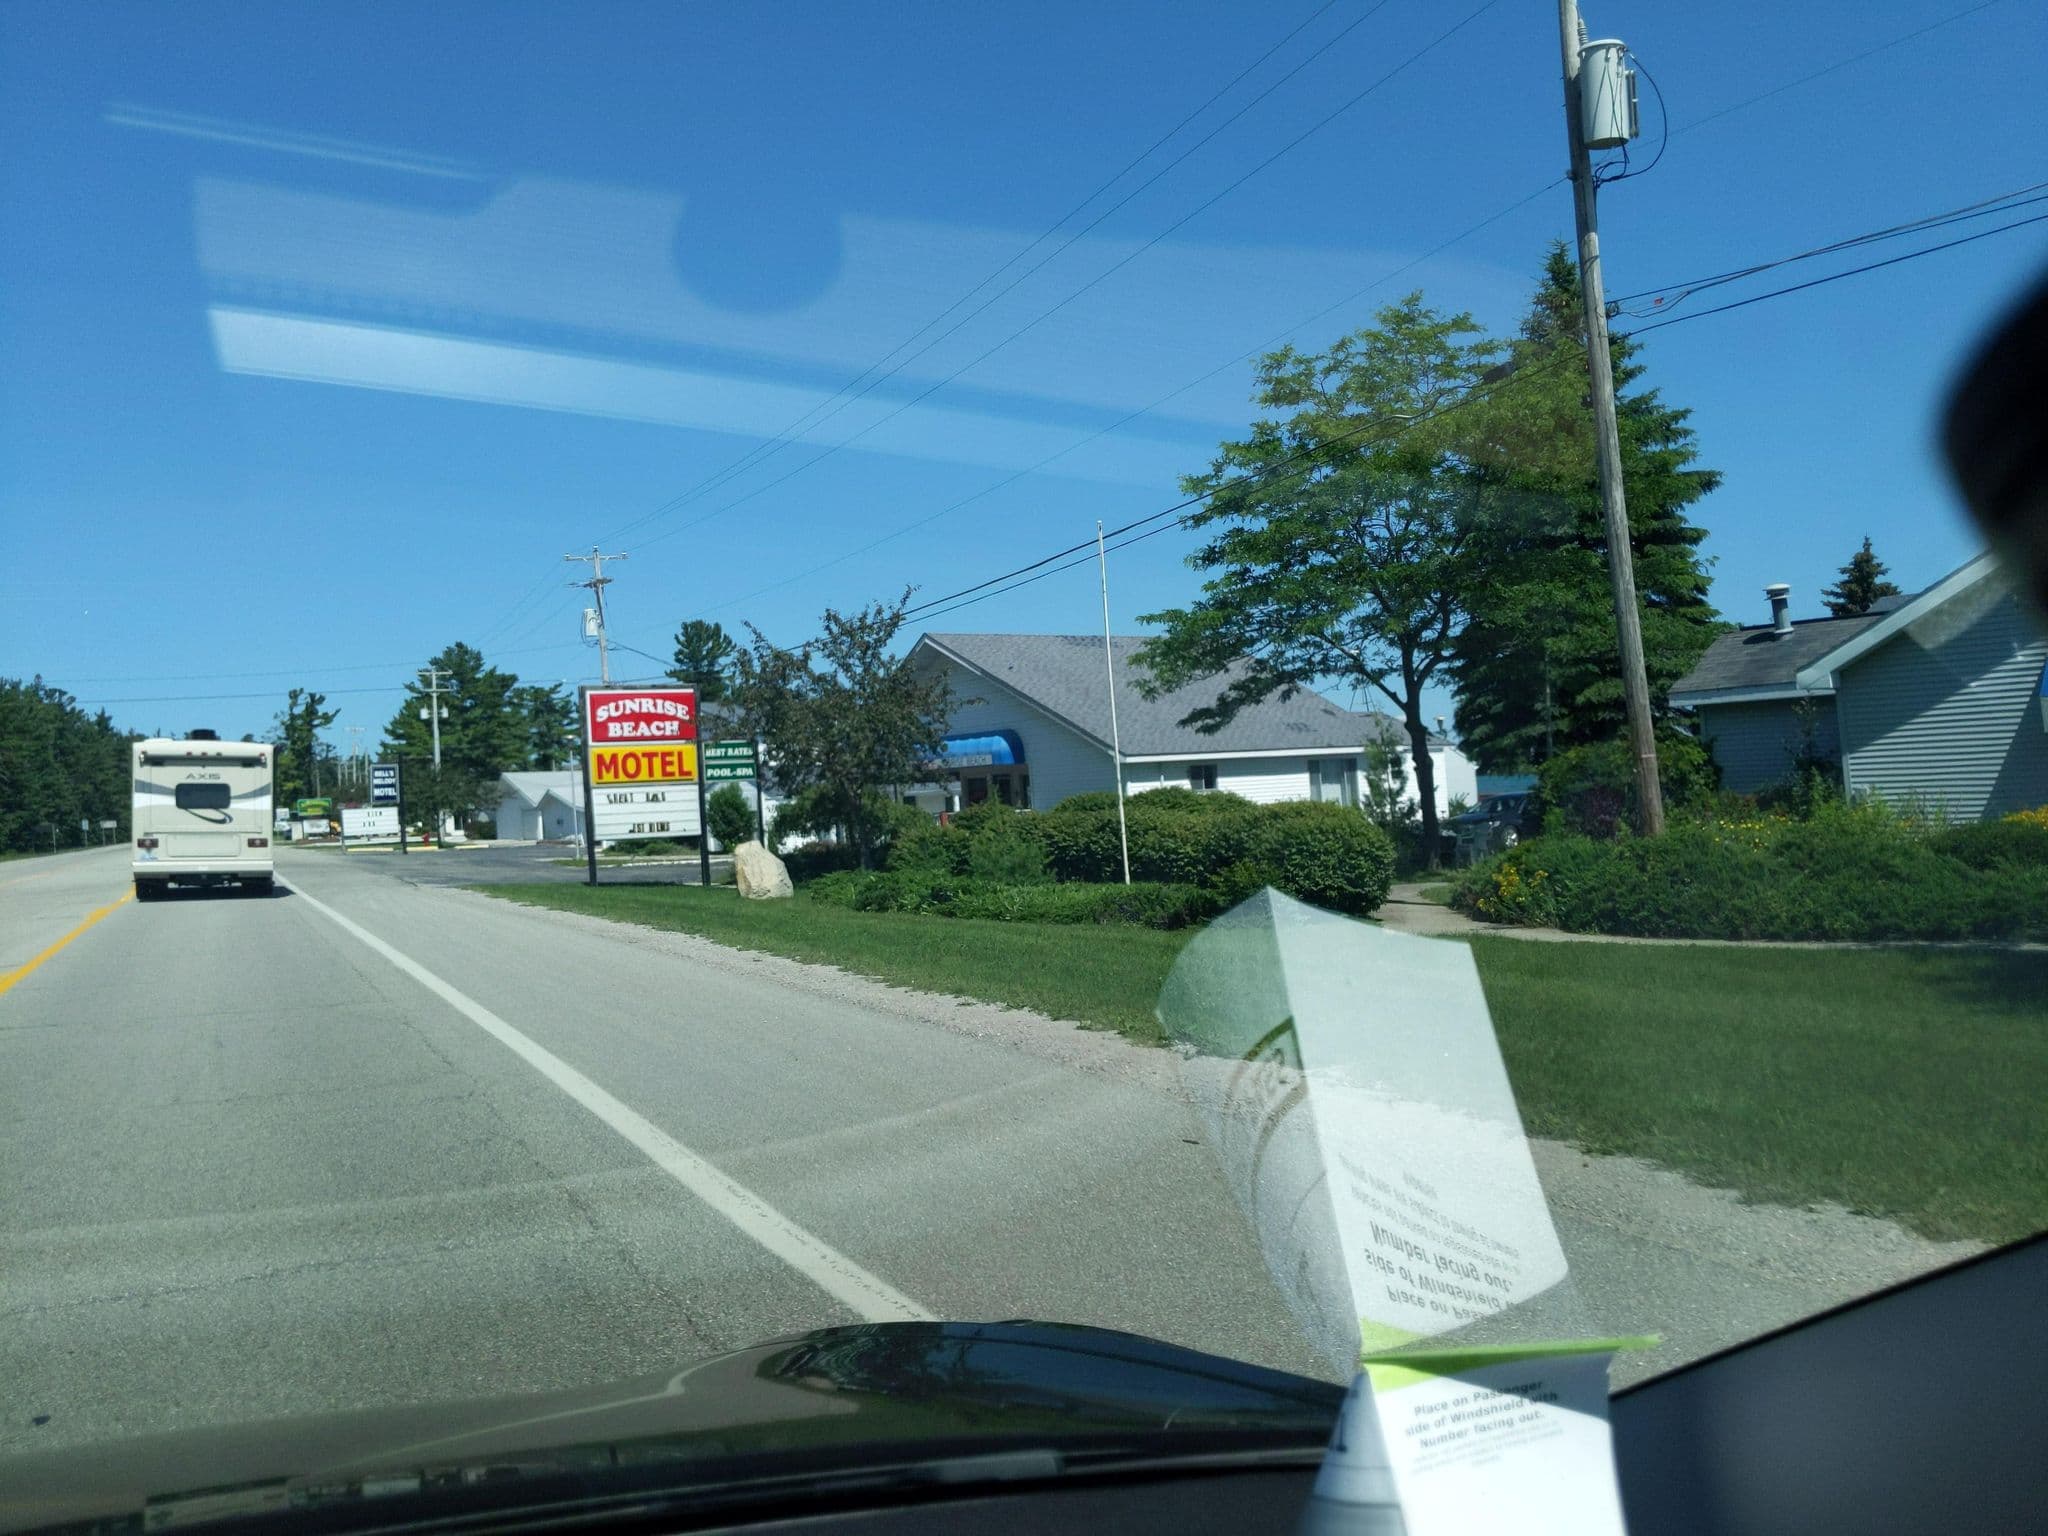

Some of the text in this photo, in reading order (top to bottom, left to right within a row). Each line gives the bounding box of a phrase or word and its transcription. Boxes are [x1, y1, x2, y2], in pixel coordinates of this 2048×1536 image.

[596, 698, 690, 723] SUNRISE
[608, 721, 680, 738] BEACH
[705, 748, 726, 757] BEST
[596, 751, 693, 780] MOTEL
[706, 767, 754, 778] POOL-SPA
[185, 772, 221, 781] AXIS
[373, 787, 397, 796] MOTEL
[1405, 1390, 1559, 1437] side of Windshield with
[1414, 1401, 1449, 1417] Place
[1452, 1396, 1469, 1407] on
[1419, 1428, 1470, 1449] Number
[1474, 1418, 1514, 1434] facing
